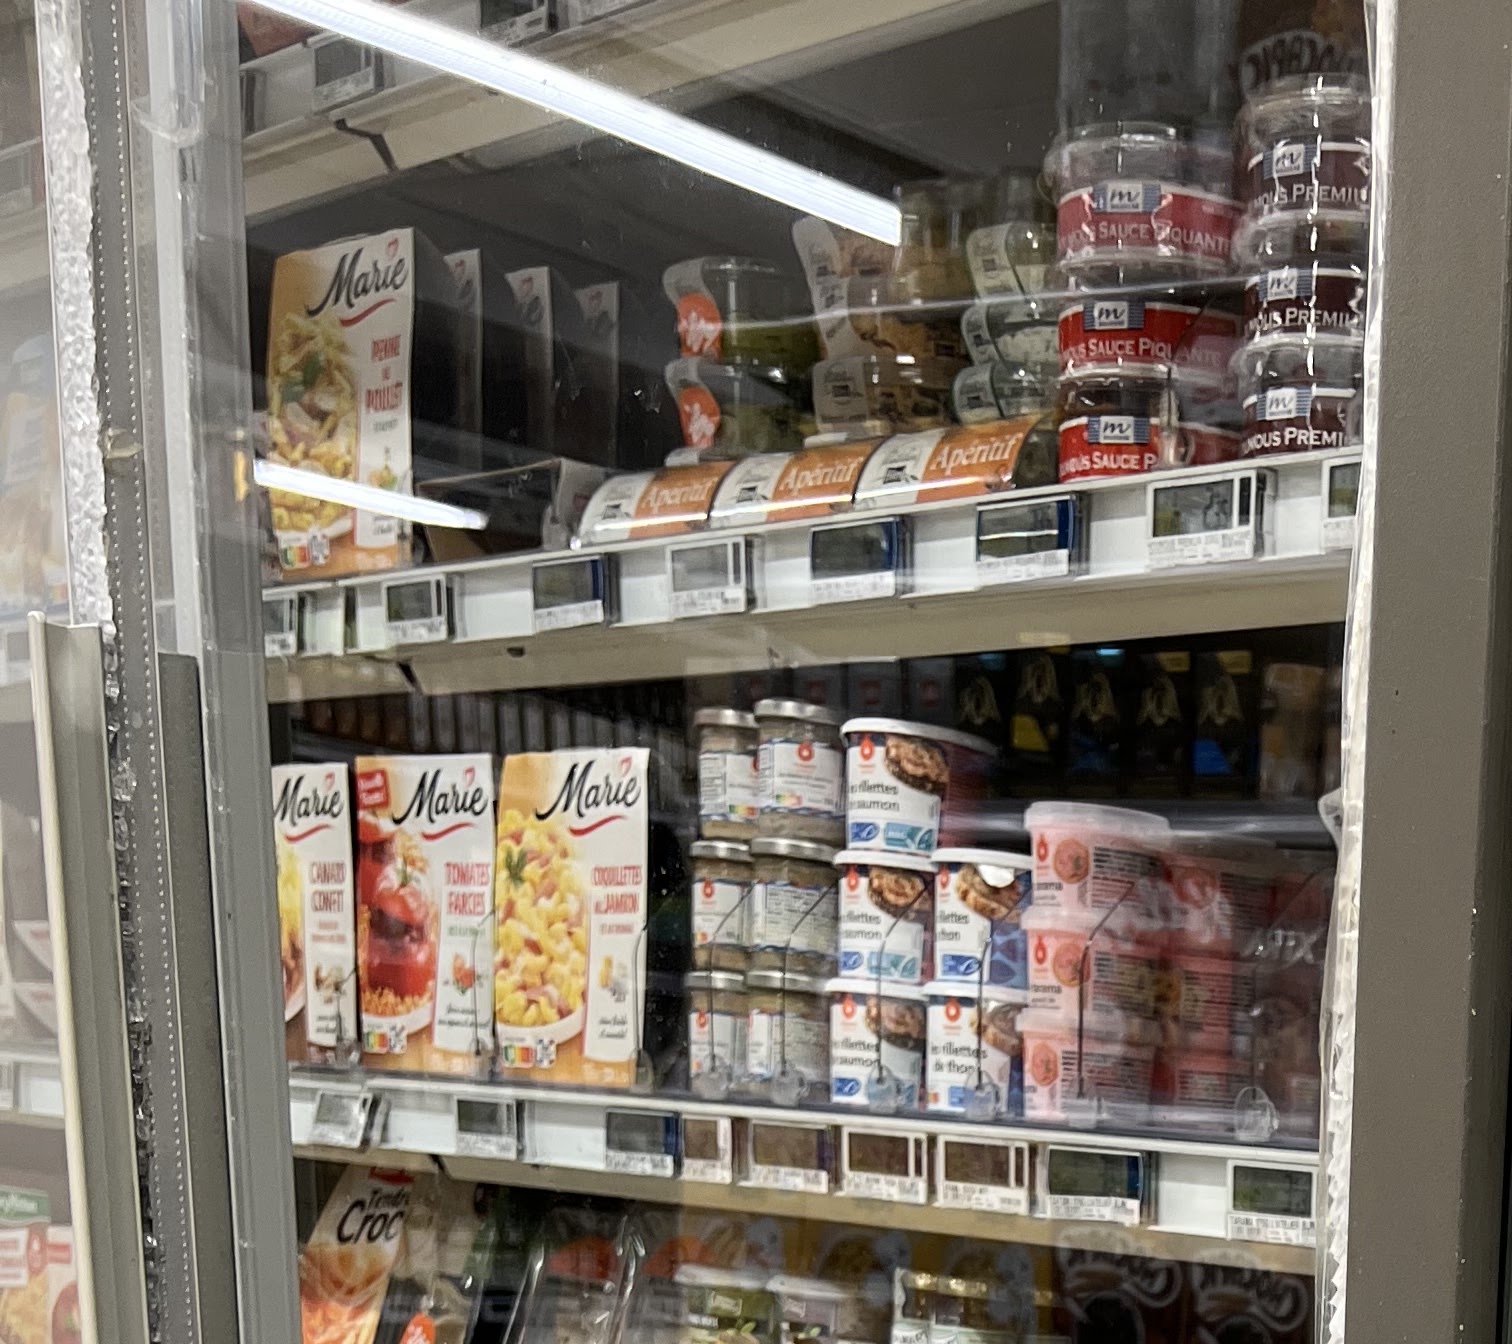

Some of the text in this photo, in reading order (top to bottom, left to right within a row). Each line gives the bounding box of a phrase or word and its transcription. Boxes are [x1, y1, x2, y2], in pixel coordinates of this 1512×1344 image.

[1100, 221, 1150, 239] SAUCE
[304, 247, 409, 317] Marie
[1088, 338, 1135, 355] SAUCE
[930, 432, 1023, 475] Apéritif
[1284, 427, 1345, 446] PREMI
[779, 457, 862, 496] Apéritif
[1092, 452, 1141, 470] SAUCE
[273, 775, 345, 827] Marie
[392, 769, 488, 825] Marie
[535, 759, 642, 821] Marie
